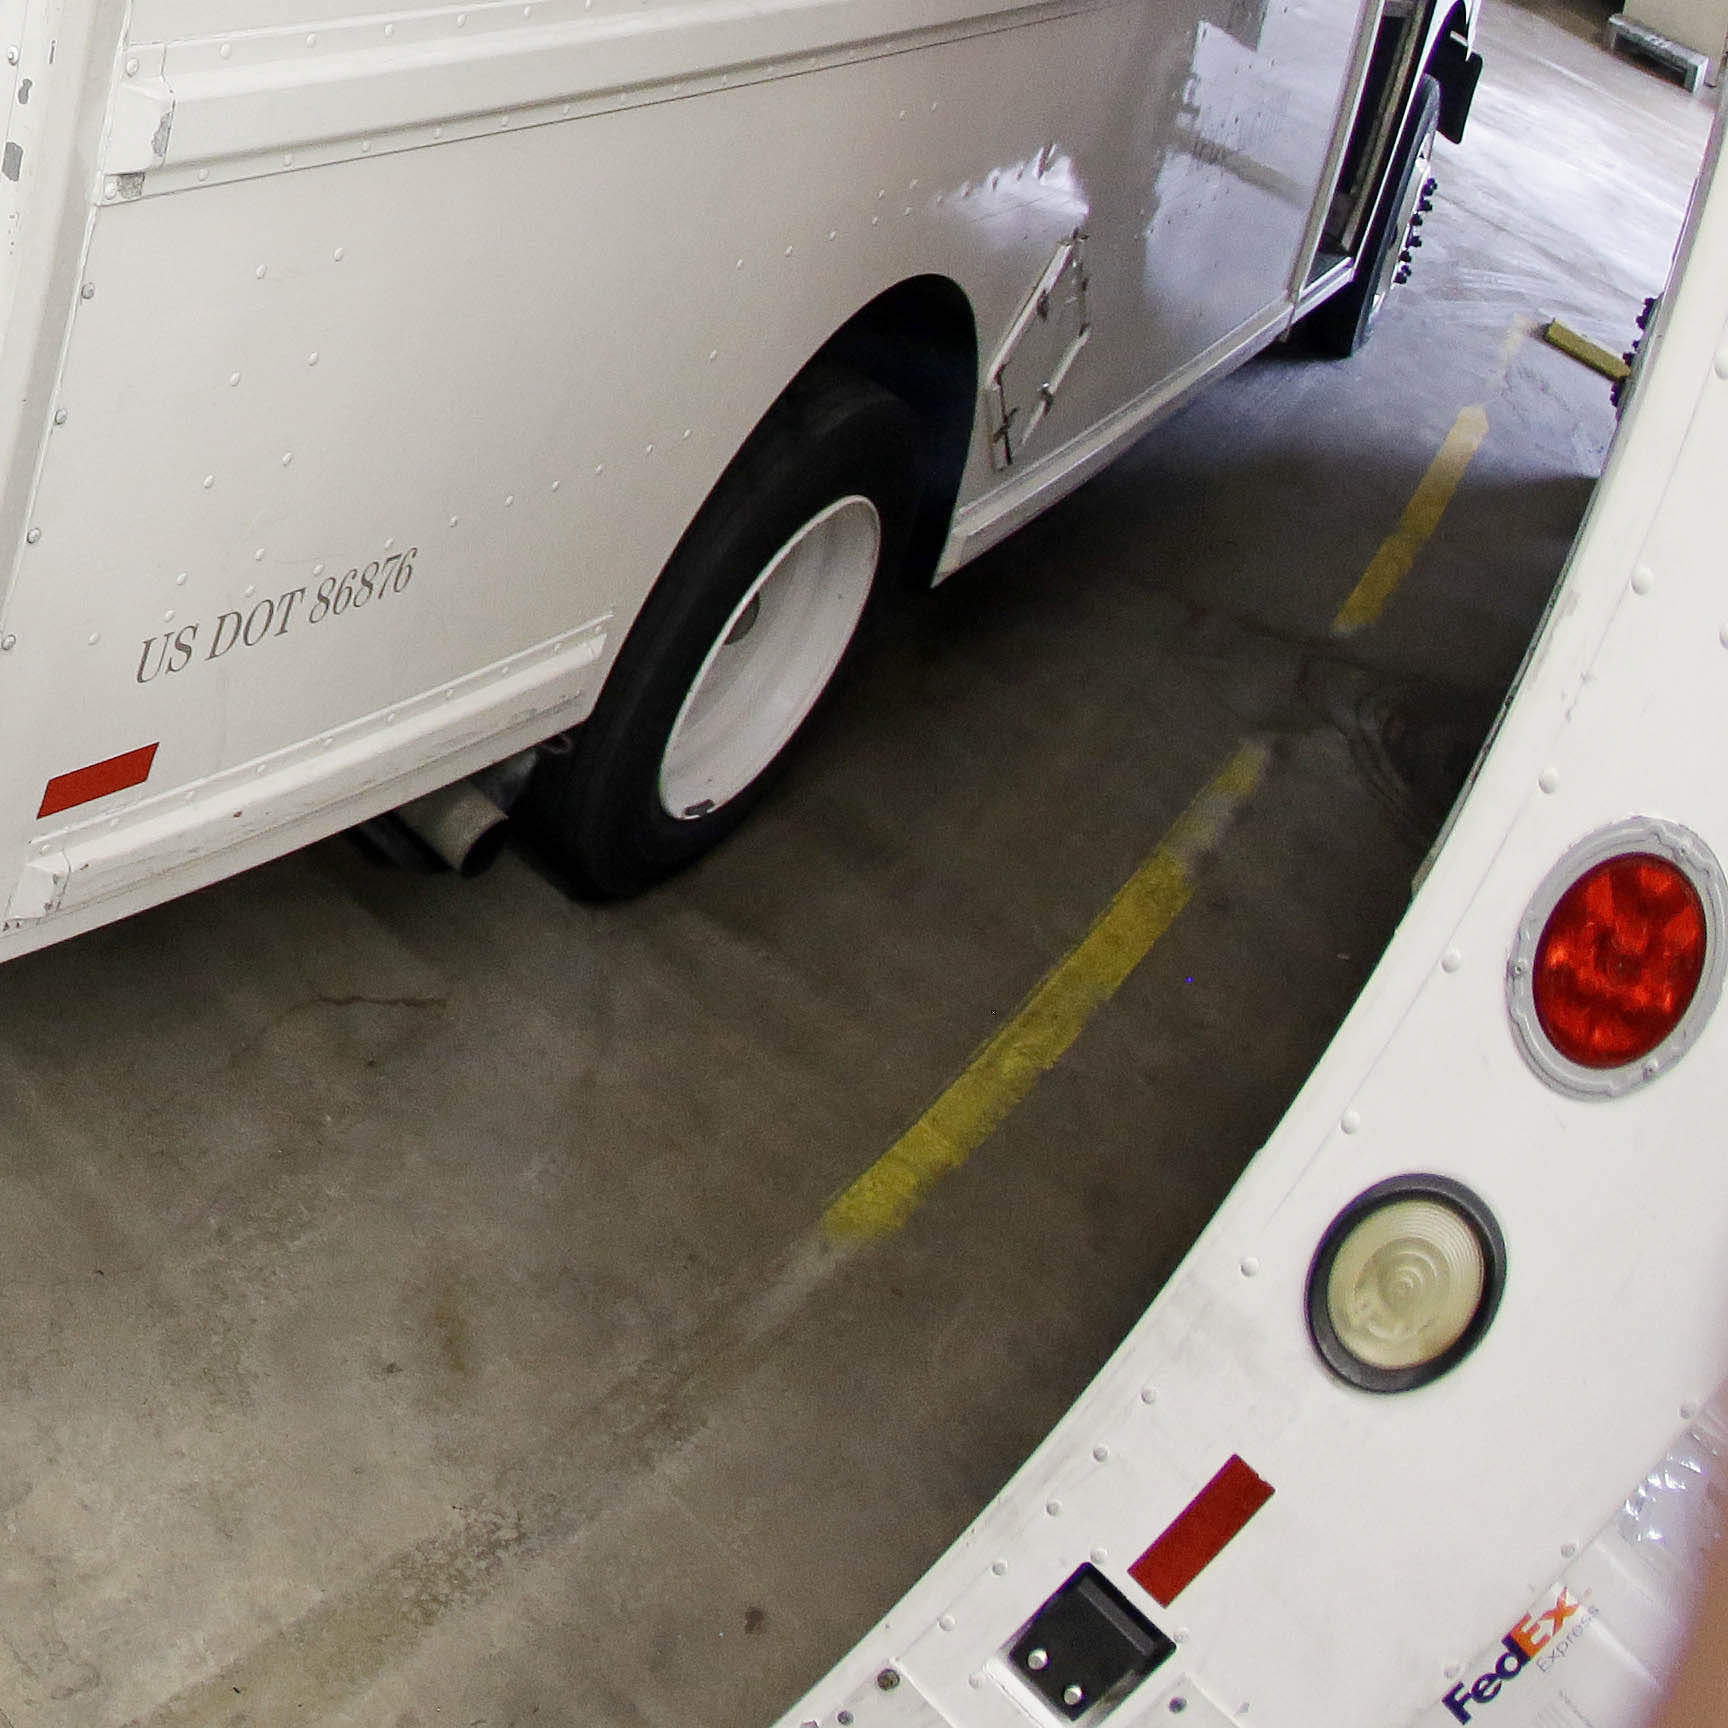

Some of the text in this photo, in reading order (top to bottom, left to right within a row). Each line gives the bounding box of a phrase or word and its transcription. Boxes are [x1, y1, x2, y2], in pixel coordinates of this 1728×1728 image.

[136, 546, 419, 684] US DOT 86876
[1441, 1586, 1580, 1726] FedEx
[1535, 1604, 1600, 1673] Express
